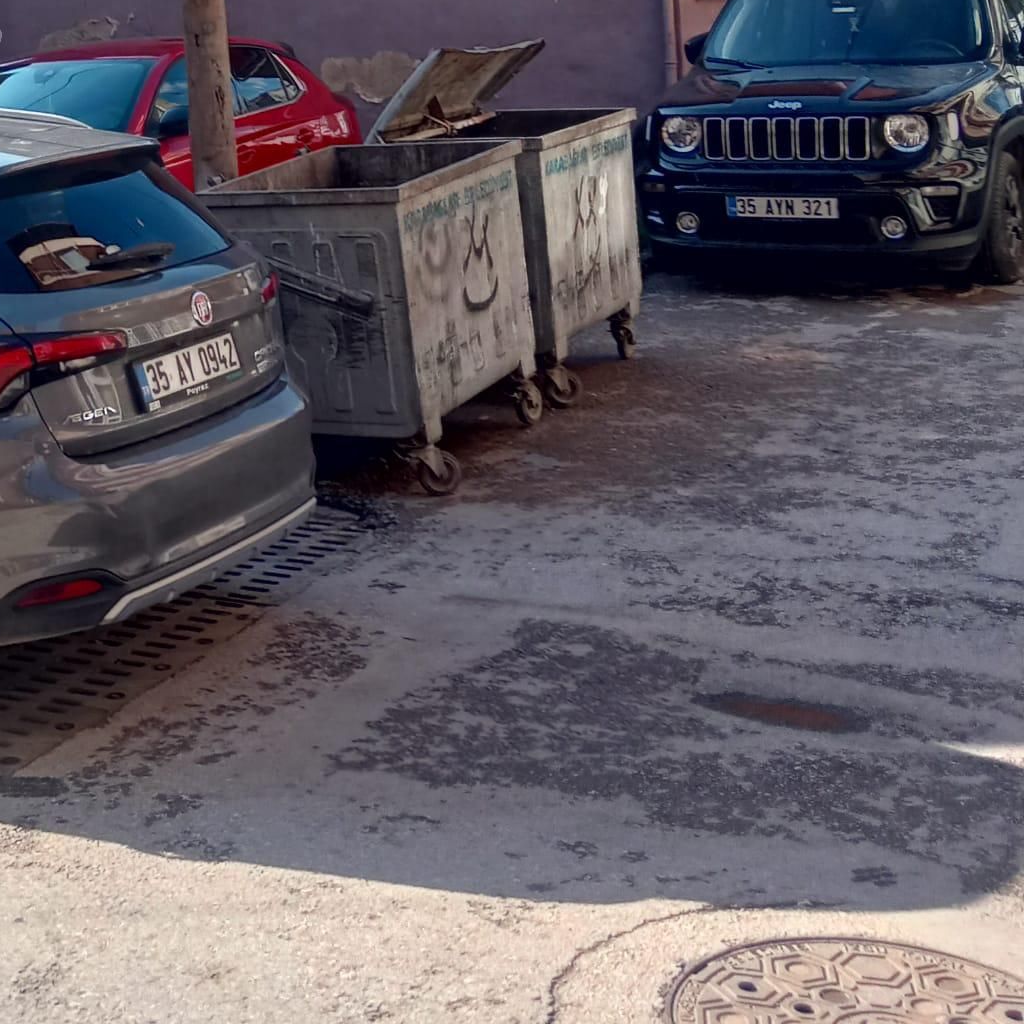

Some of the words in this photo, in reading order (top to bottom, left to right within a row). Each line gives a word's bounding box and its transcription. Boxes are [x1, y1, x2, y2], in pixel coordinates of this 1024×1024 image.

[767, 100, 803, 111] Jeep
[737, 198, 757, 216] 35
[765, 199, 795, 216] AYN
[802, 199, 833, 217] 321
[146, 360, 171, 395] 35
[176, 351, 195, 385] AY
[198, 338, 237, 376] 0942
